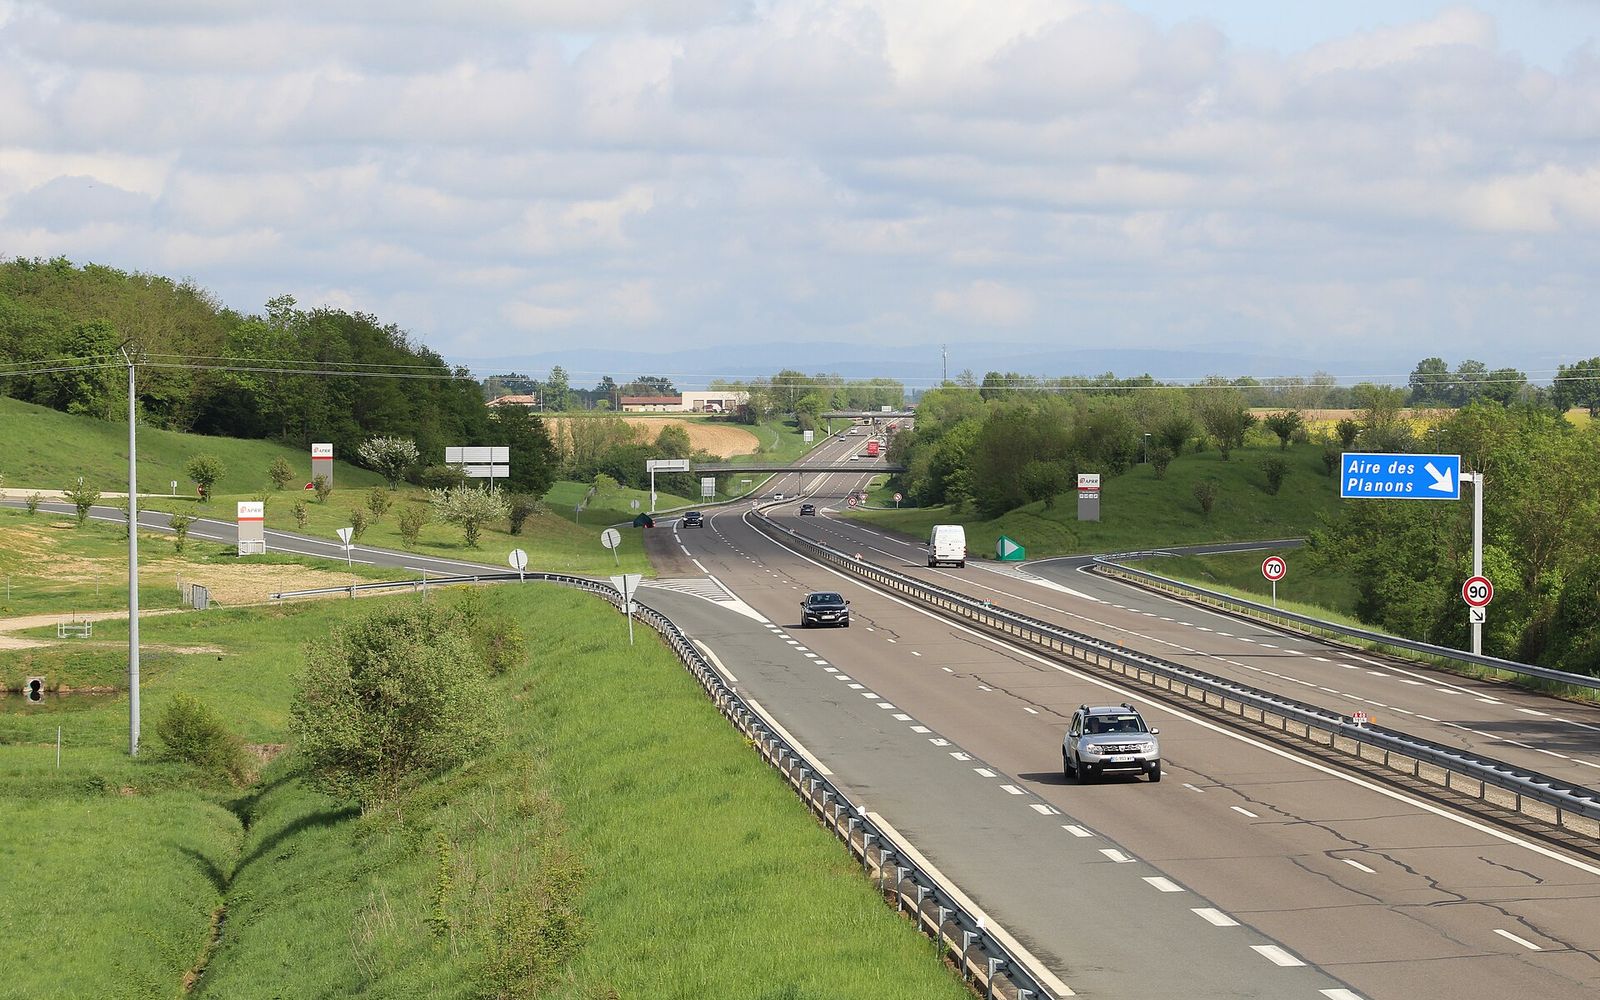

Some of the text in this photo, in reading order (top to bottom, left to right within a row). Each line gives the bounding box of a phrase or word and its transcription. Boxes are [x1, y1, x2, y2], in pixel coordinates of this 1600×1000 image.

[1347, 460, 1415, 475] Aire des
[1347, 478, 1413, 492] Planons
[1268, 564, 1281, 574] 70
[1469, 586, 1487, 598] 90
